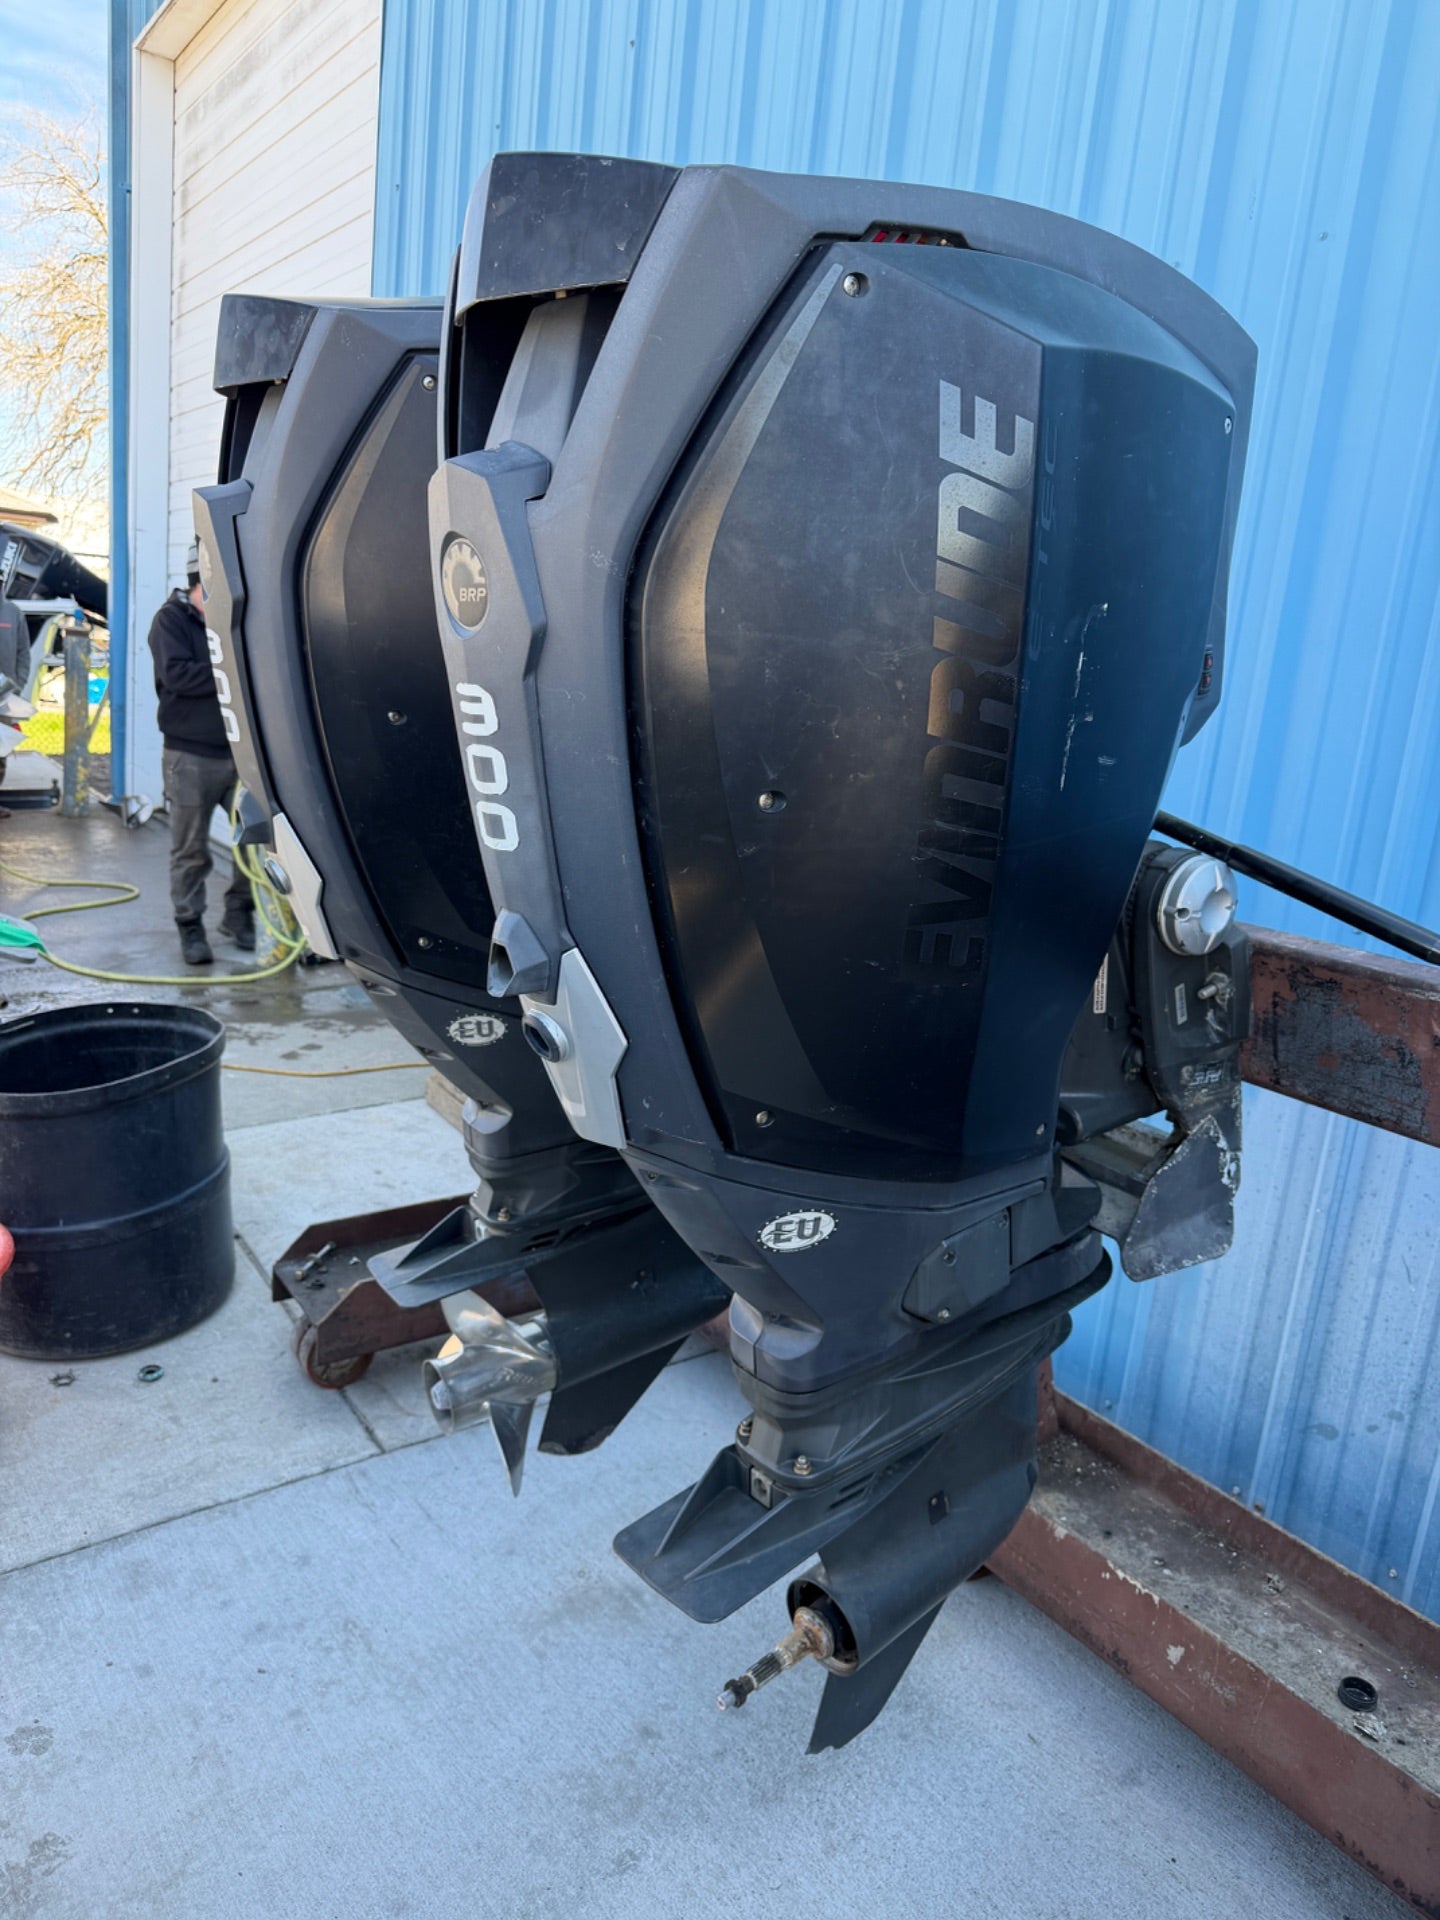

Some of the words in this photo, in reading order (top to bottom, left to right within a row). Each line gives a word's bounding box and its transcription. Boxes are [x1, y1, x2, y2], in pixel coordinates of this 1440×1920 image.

[459, 586, 487, 603] BRP
[902, 378, 1035, 970] EVINRUDE
[455, 683, 519, 852] 300
